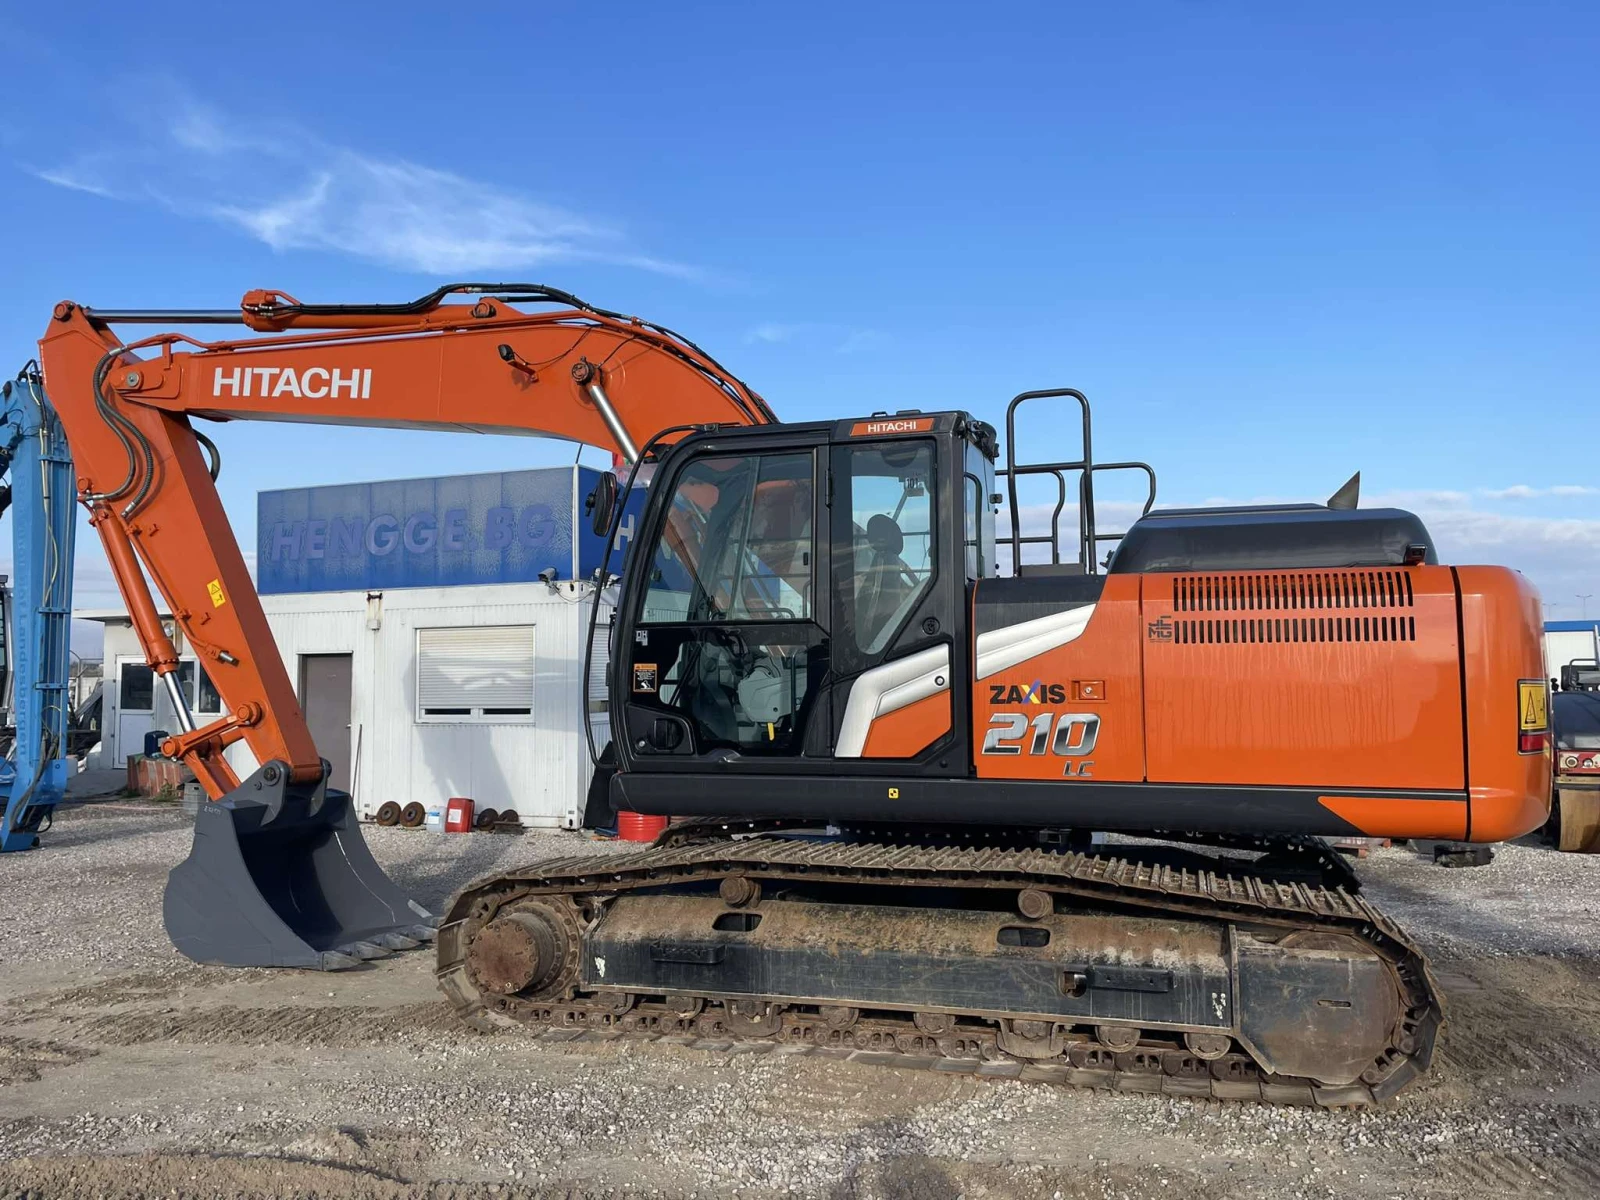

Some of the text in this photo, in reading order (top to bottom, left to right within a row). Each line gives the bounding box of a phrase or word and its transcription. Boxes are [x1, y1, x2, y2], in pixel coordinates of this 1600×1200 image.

[213, 367, 372, 399] HITACHI
[867, 421, 917, 433] HITACHI
[270, 504, 556, 562] HENGGE.BG
[990, 679, 1066, 704] ZAXIS
[981, 712, 1101, 756] 210
[1063, 760, 1095, 777] LC
